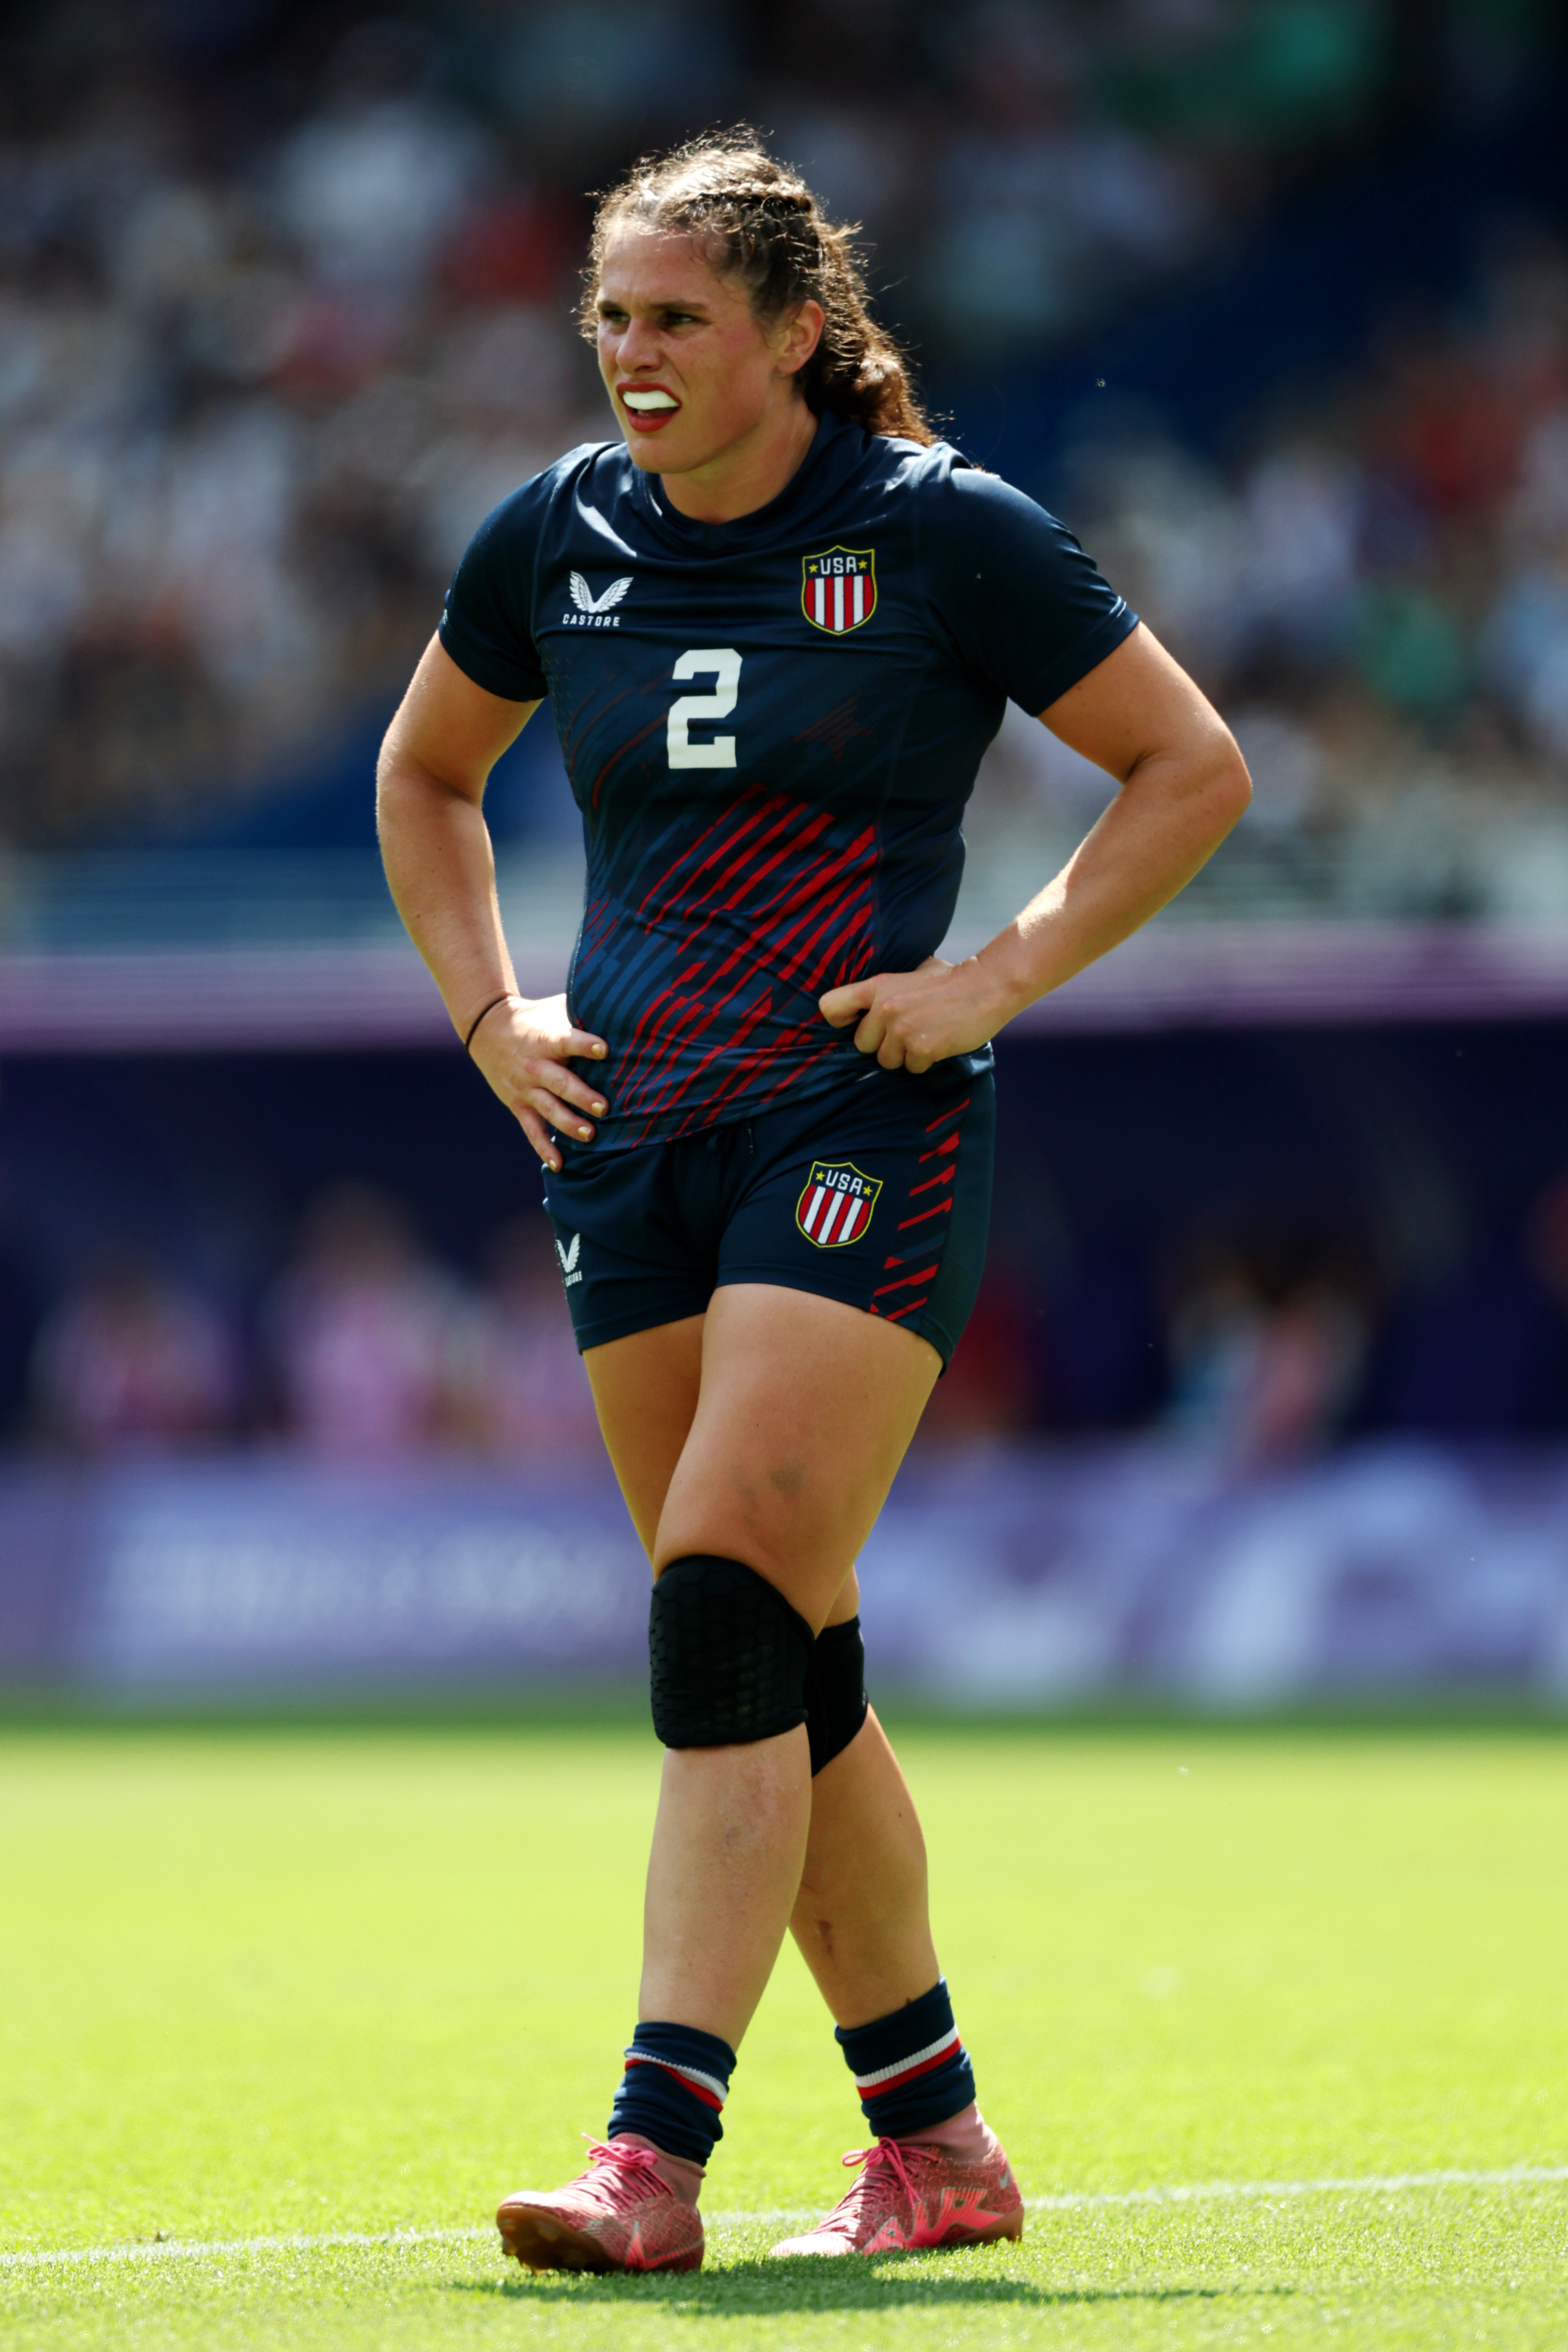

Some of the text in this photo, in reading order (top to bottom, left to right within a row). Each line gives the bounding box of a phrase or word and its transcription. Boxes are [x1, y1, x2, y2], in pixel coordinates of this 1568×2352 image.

[820, 556, 857, 575] USA
[562, 613, 620, 627] CASTORE
[667, 648, 743, 769] 2
[826, 1169, 863, 1195] USA
